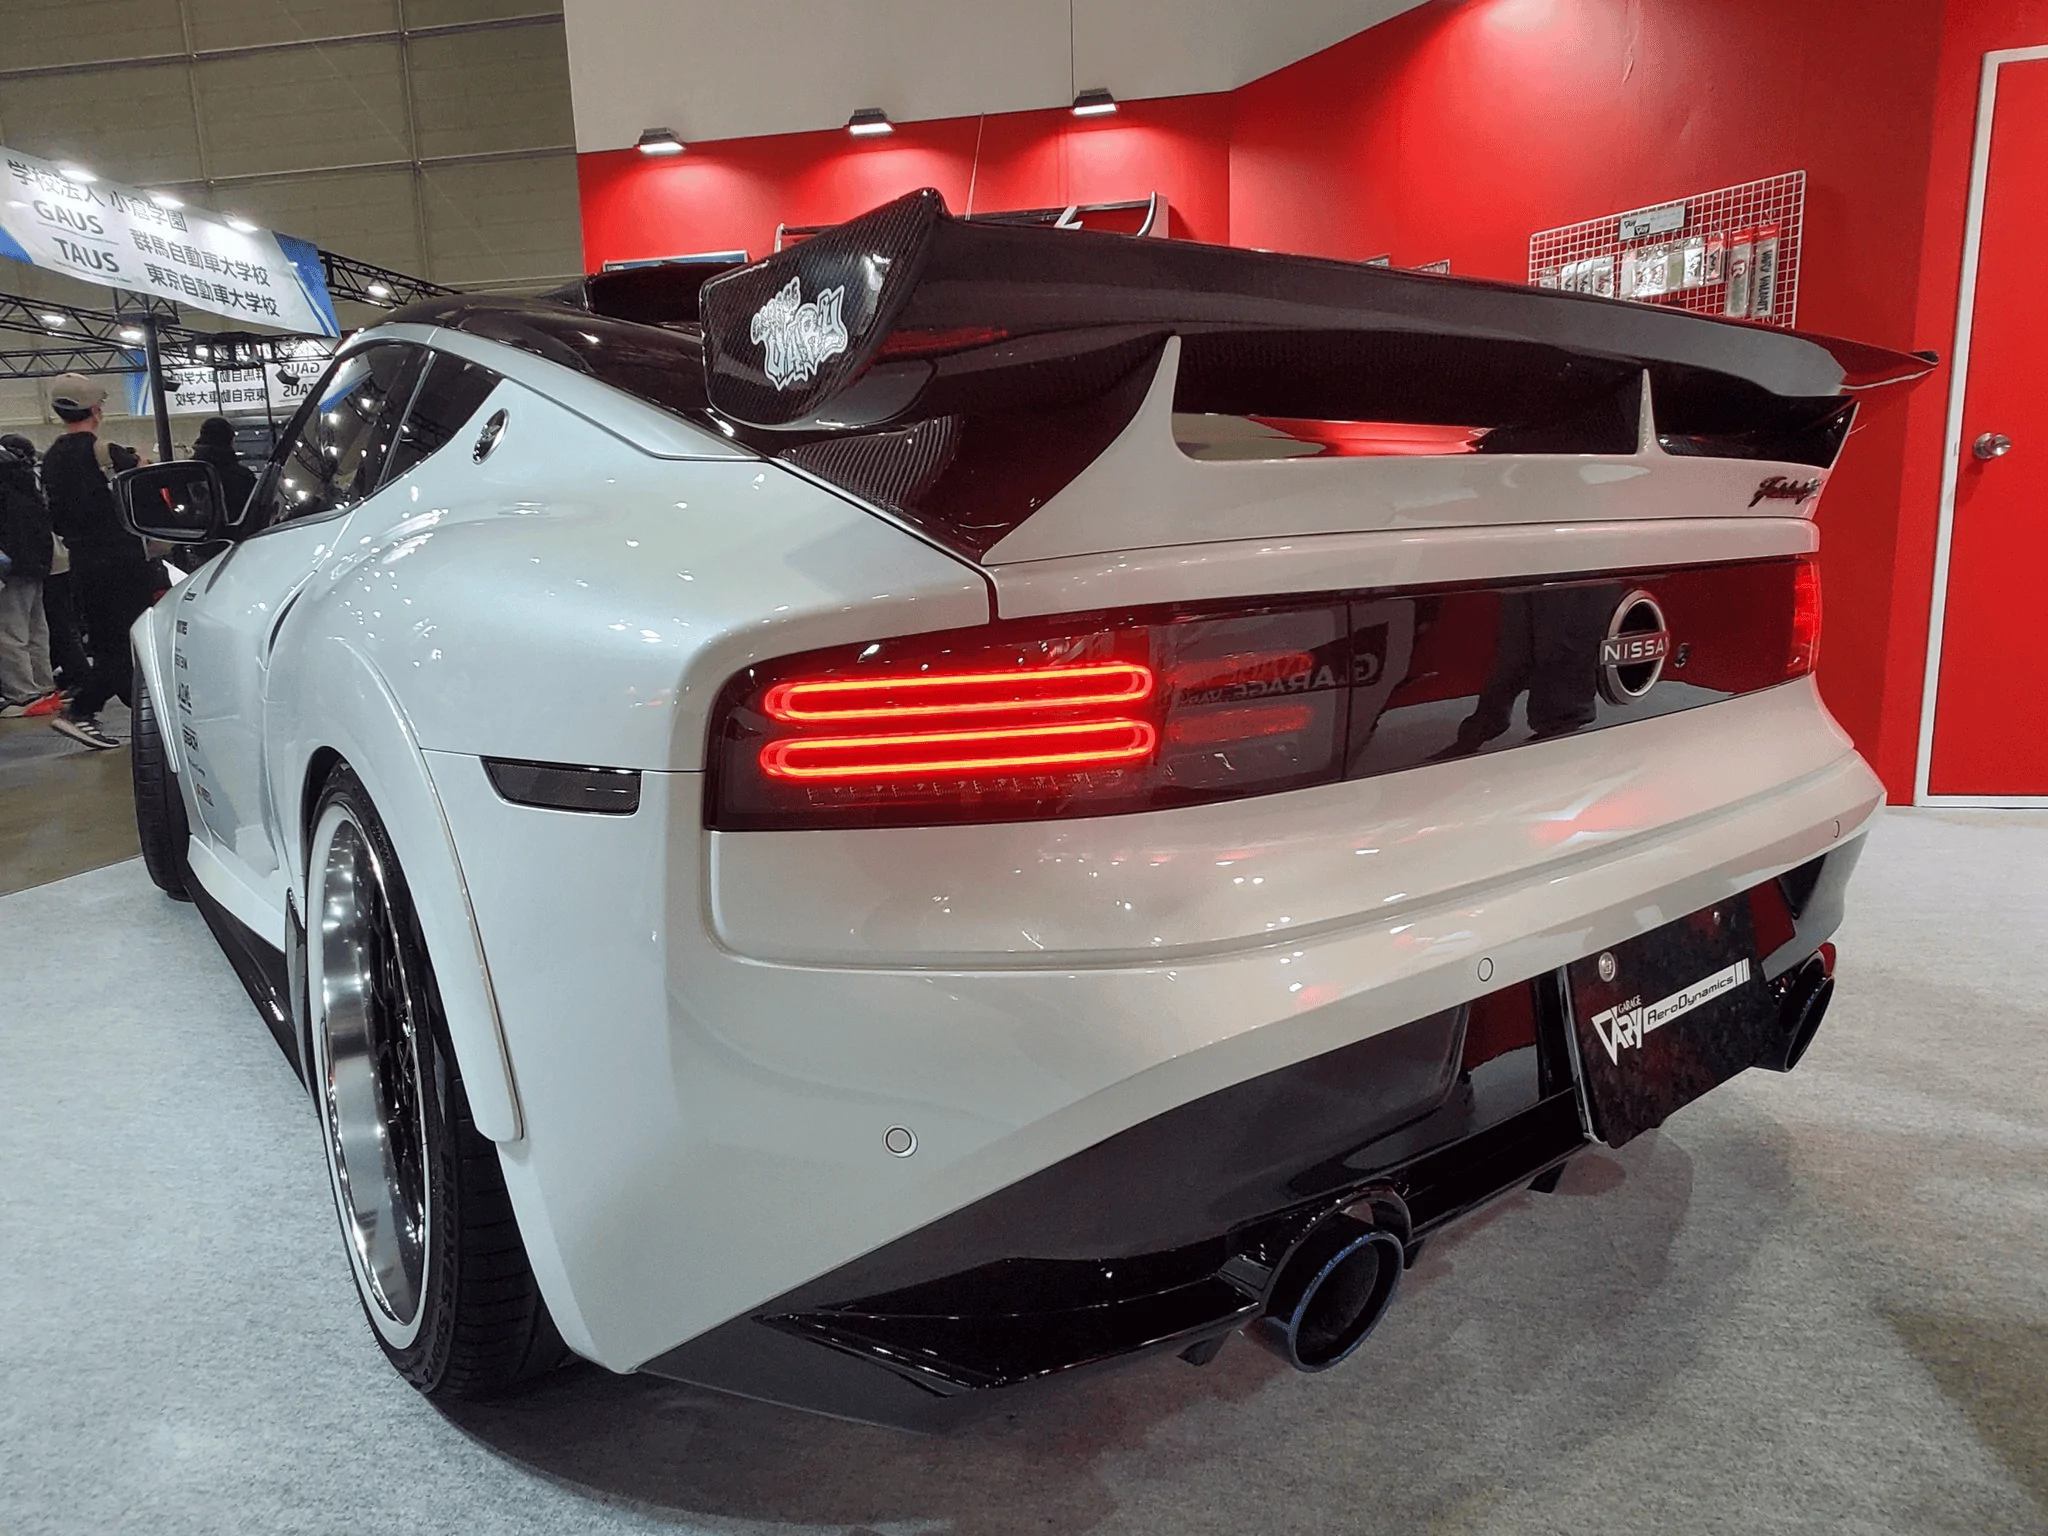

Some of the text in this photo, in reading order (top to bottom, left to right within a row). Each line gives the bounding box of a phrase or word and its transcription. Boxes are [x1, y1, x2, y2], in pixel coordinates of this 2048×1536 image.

[33, 199, 104, 234] GAUS
[51, 236, 119, 273] TAUS
[129, 228, 271, 287] 群馬自動車大学校
[144, 262, 280, 317] 東京自動車大学校
[1604, 637, 1669, 662] NISSA
[1647, 976, 1734, 1026] AeroDynamics
